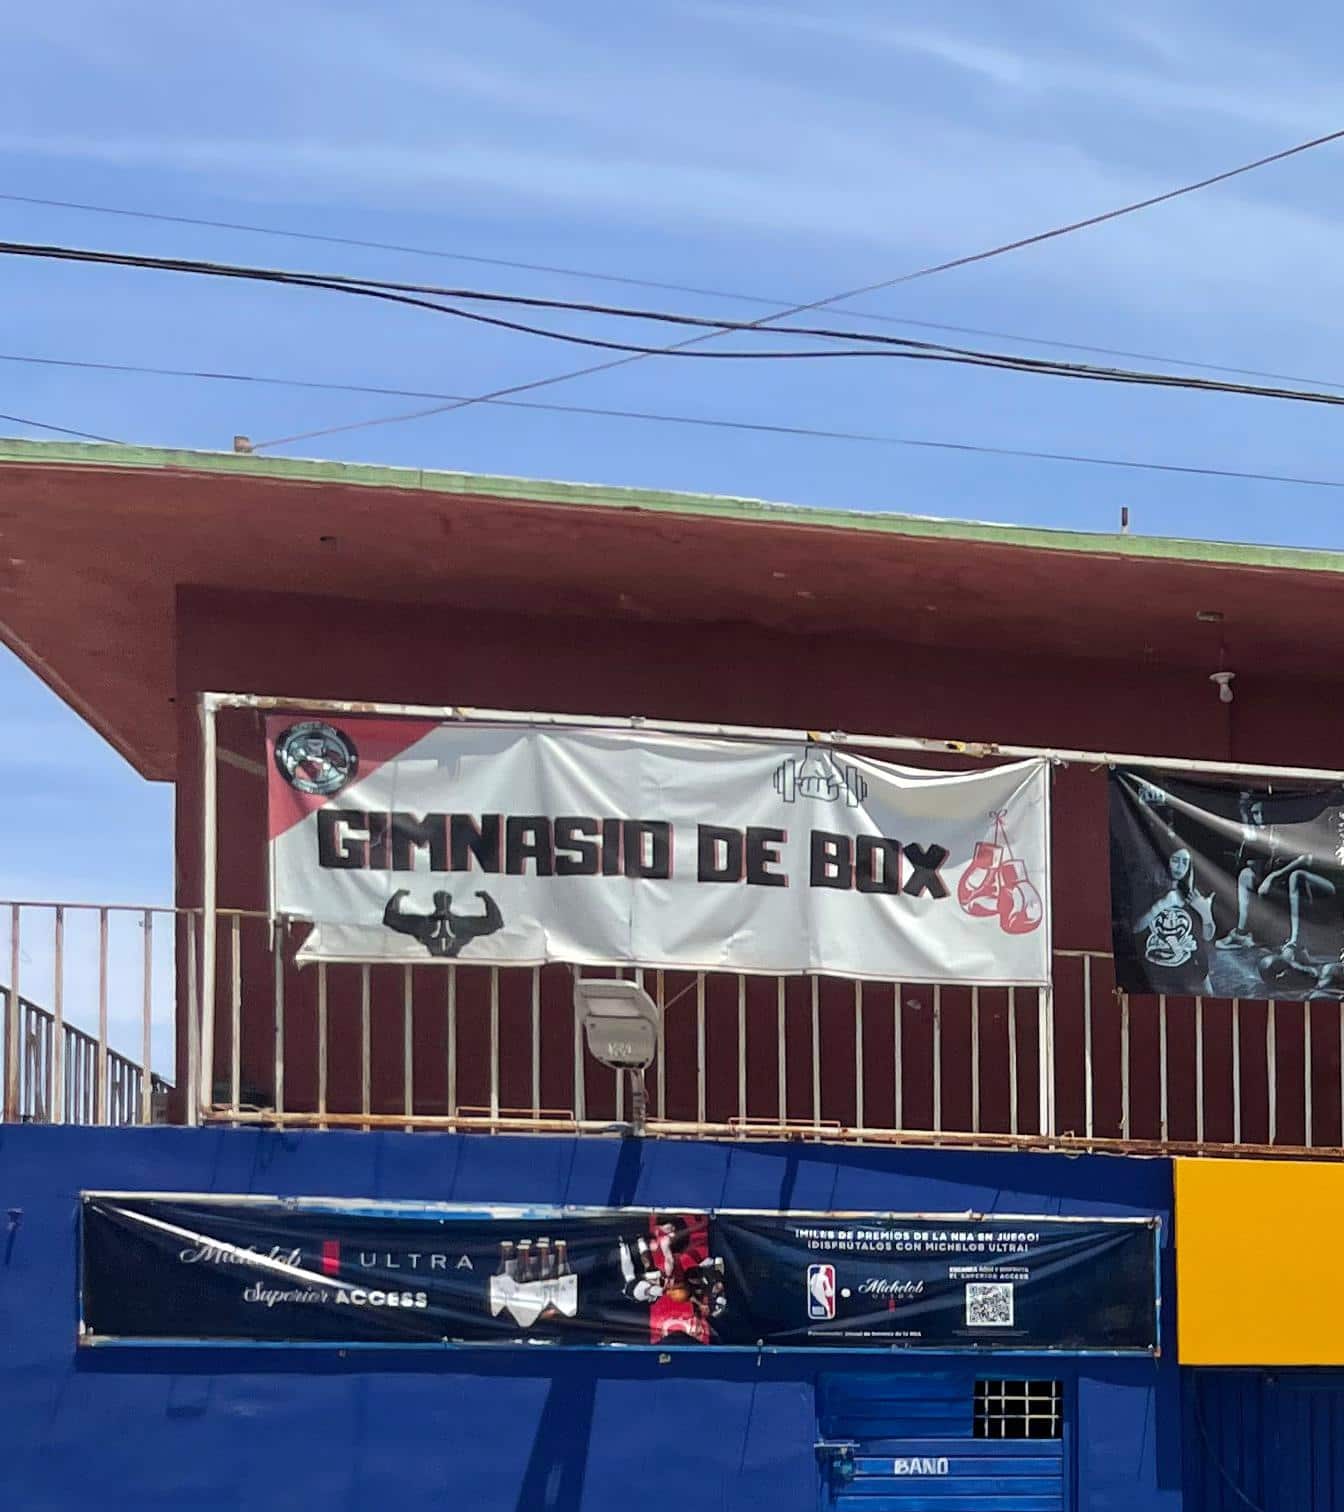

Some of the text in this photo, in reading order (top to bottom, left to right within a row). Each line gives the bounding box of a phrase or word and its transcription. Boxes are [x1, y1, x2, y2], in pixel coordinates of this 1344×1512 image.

[317, 809, 951, 900] GIMNASIO DE BOX
[838, 1231, 854, 1240] DE
[857, 1231, 909, 1240] PREMIOS
[913, 1232, 929, 1241] DE
[932, 1232, 947, 1241] LA
[951, 1232, 975, 1241] NBA
[895, 1242, 922, 1251] CON
[925, 1243, 985, 1252] MICHELOB
[360, 1252, 474, 1269] ULTRA
[858, 1278, 924, 1294] Michelob
[244, 1281, 428, 1309] Superior ACCESS
